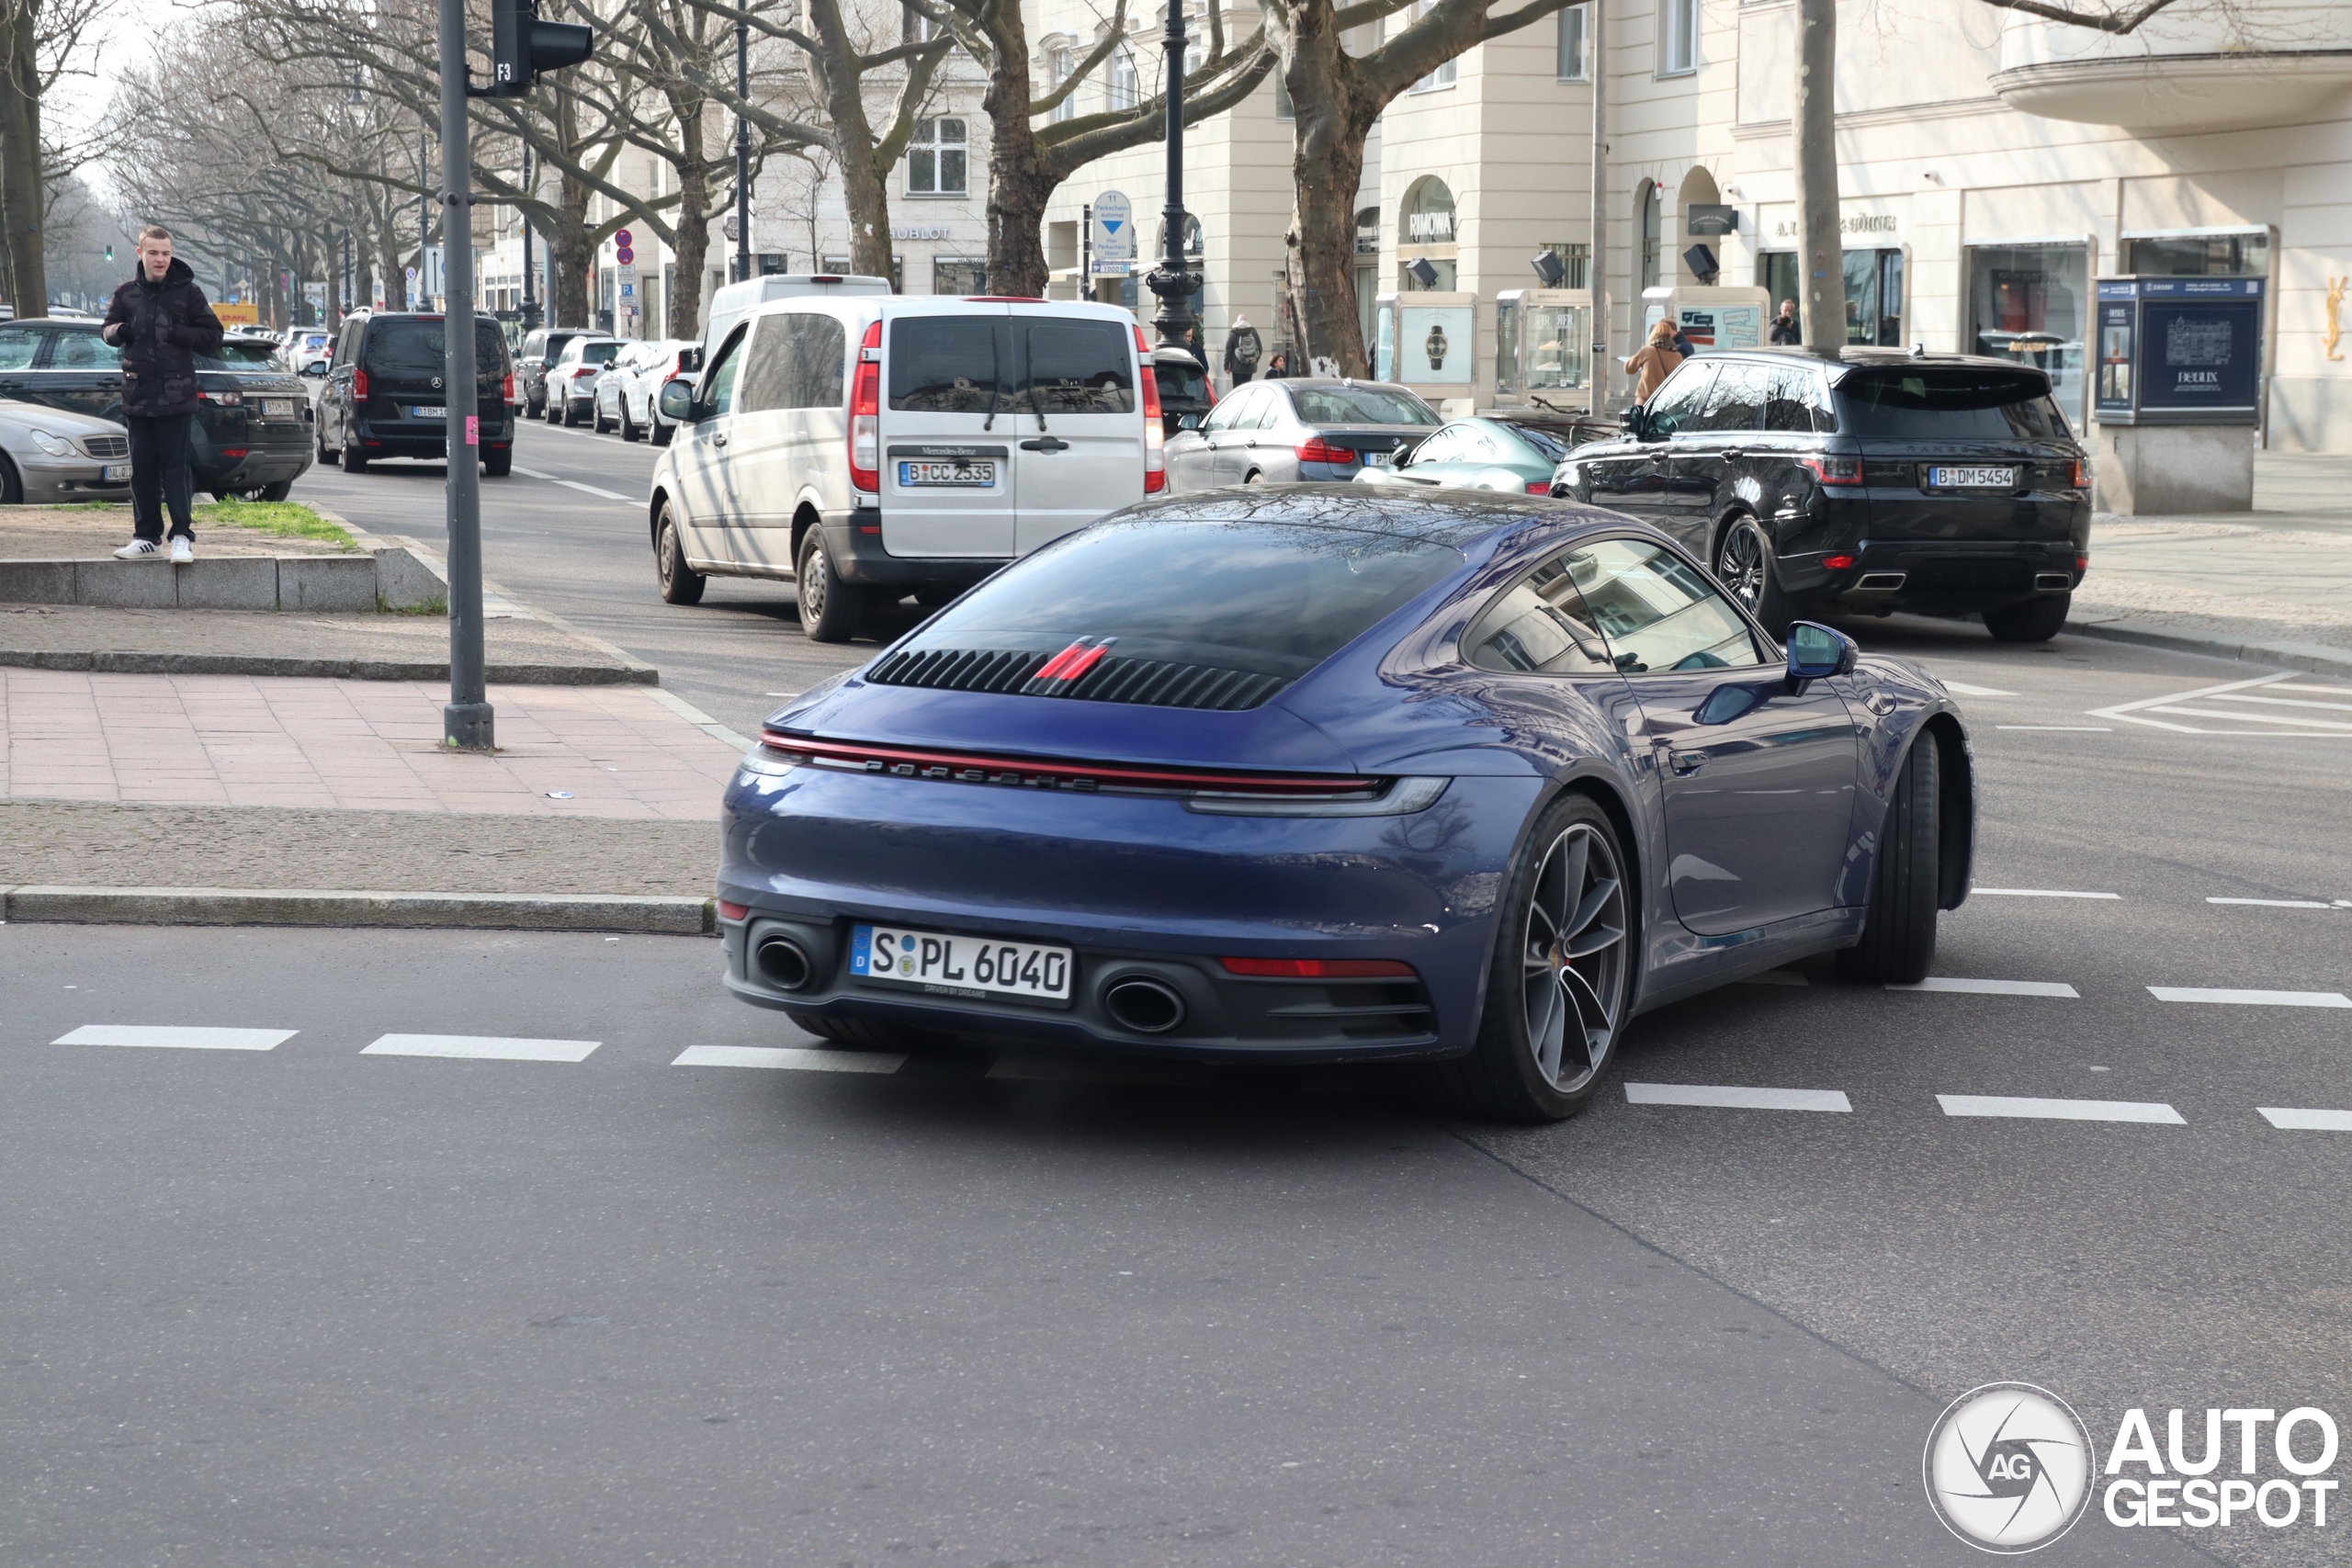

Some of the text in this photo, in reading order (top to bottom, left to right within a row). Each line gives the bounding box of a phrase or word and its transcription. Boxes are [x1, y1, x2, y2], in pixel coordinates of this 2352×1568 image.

[497, 62, 512, 82] F3
[1409, 211, 1452, 236] RIMOWA
[889, 228, 950, 240] HUBLOT
[922, 446, 977, 456] Mercedes-Benz
[910, 465, 992, 480] B CC 2535
[1939, 469, 1948, 484] B
[1957, 469, 1975, 484] DM
[1977, 469, 2011, 484] 5454
[865, 760, 1098, 792] PORSCHE
[873, 932, 896, 972] S
[921, 937, 964, 981] PL
[974, 944, 1066, 992] 6040
[924, 984, 987, 998] DRIVEN BY DREAMS
